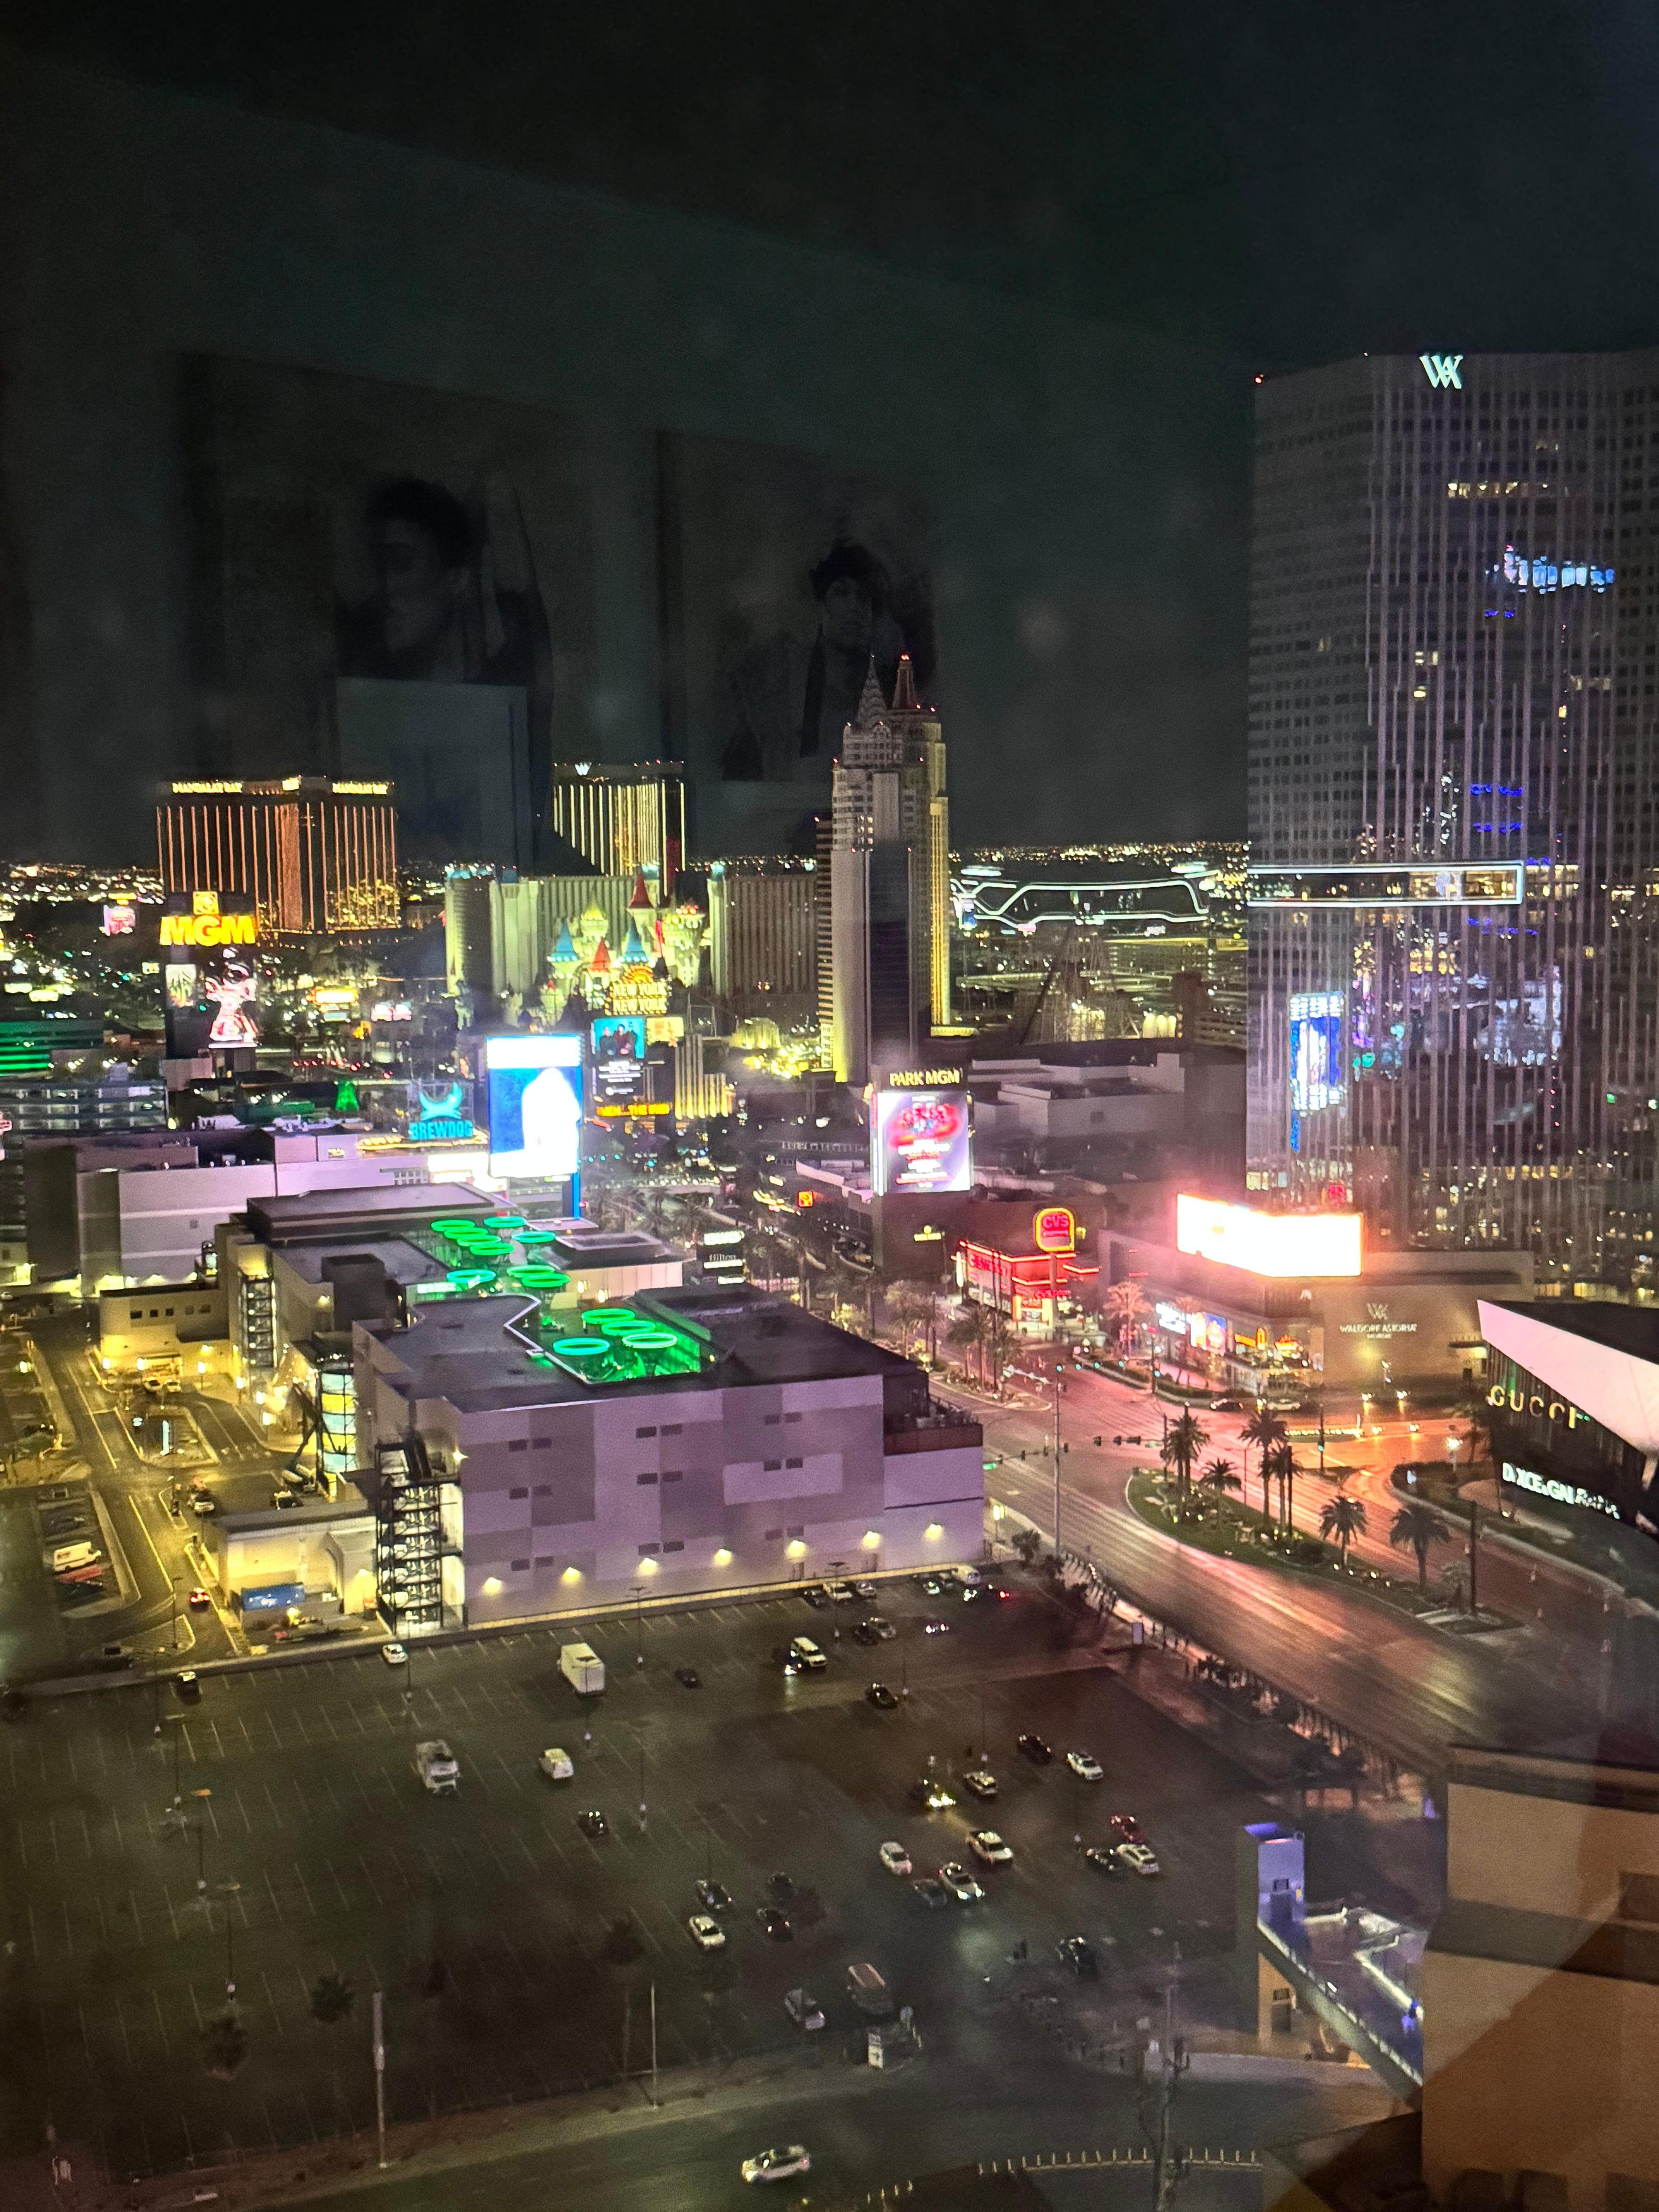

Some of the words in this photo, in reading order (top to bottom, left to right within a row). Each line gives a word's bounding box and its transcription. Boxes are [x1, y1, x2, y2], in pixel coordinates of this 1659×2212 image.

[160, 915, 255, 946] MGM
[613, 981, 637, 997] NEW
[613, 998, 637, 1012] NEW
[890, 1072, 924, 1086] PARK
[925, 1069, 960, 1084] MGM
[409, 1120, 472, 1140] BREWDOG
[1042, 1215, 1069, 1228] CVS
[1490, 1385, 1577, 1429] GUCCI
